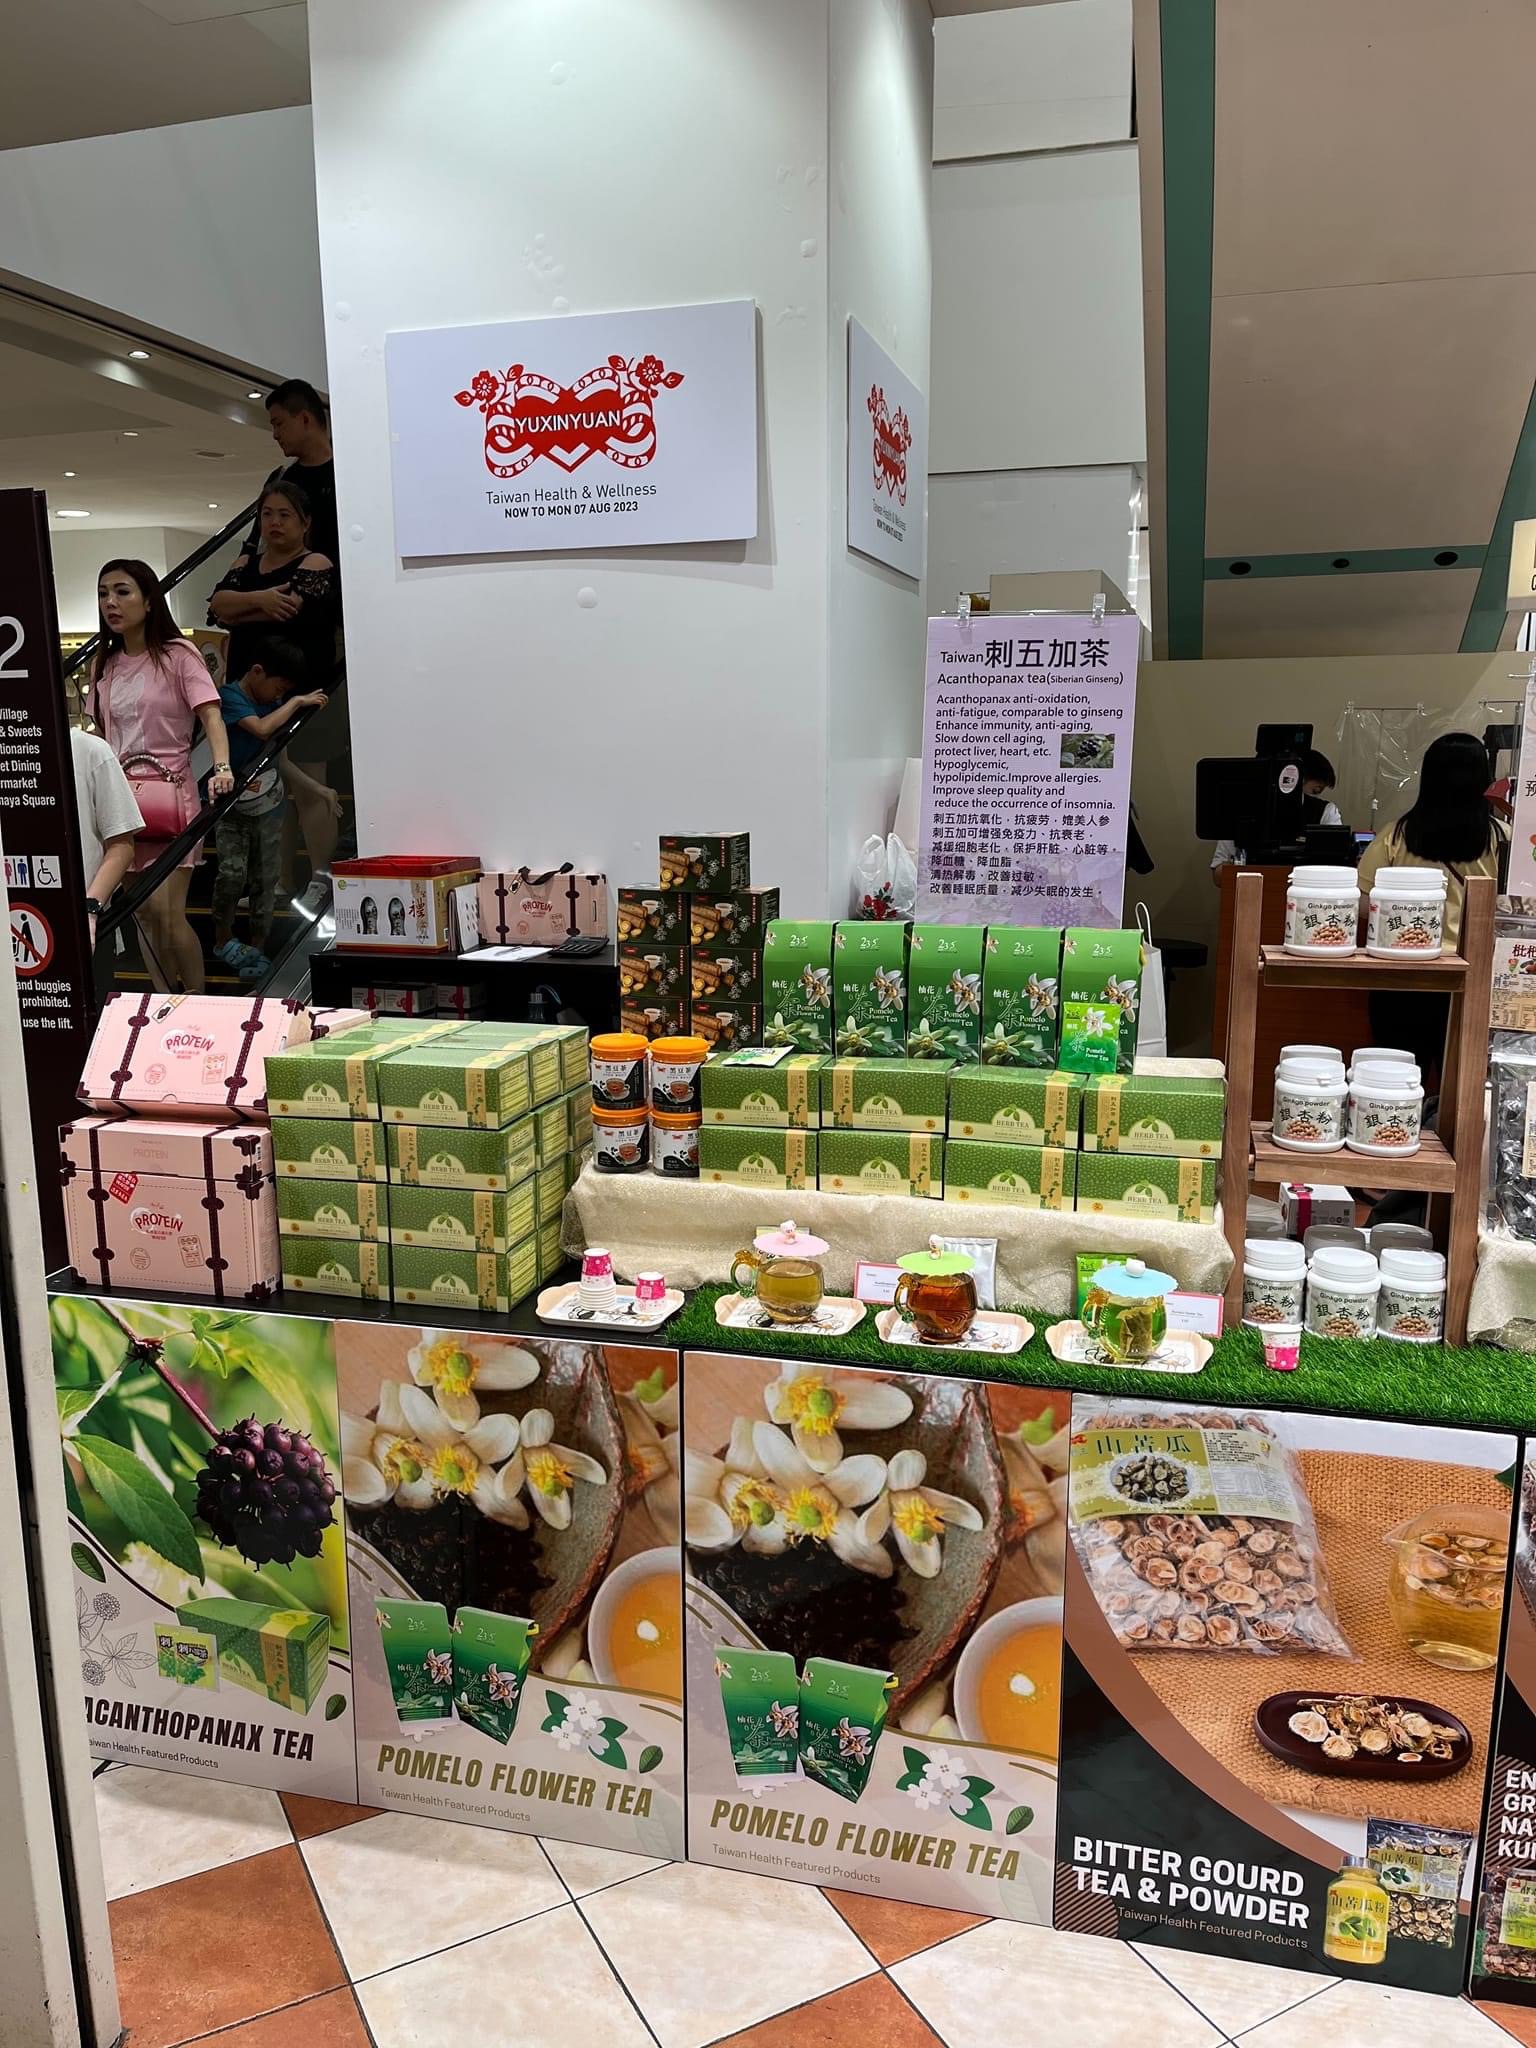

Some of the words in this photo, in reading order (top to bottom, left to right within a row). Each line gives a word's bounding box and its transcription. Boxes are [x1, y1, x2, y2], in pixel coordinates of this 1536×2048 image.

[515, 410, 621, 433] YUXINYUAN
[486, 491, 530, 504] Taiwan
[535, 487, 577, 501] Health
[582, 486, 592, 498] &
[596, 484, 657, 498] Wellness
[504, 507, 529, 518] NOW
[532, 506, 544, 517] TO
[548, 504, 571, 516] MON
[574, 504, 585, 514] 07
[589, 502, 610, 514] AUG
[614, 501, 638, 512] 2023
[941, 651, 984, 663] Taiwan
[984, 639, 1109, 668] 刺五加茶
[938, 673, 1023, 686] Acanthopanax
[1086, 672, 1124, 685] Ginseng)
[937, 694, 1010, 706] Acanthopanax
[1013, 693, 1091, 705] anti-oxidation,
[936, 707, 999, 719] anti-fatigue,
[1002, 707, 1064, 719] comparable
[1067, 709, 1077, 717] to
[1081, 708, 1123, 719] ginseng
[8, 726, 42, 737] Sweets
[936, 721, 978, 730] Enhance
[981, 721, 1032, 731] immunity,
[1035, 721, 1092, 732] anti-aging,
[935, 733, 958, 743] Slow
[962, 733, 990, 743] down
[993, 734, 1010, 743] cell
[1013, 734, 1045, 745] aging,
[935, 747, 970, 758] protect
[974, 747, 996, 757] liver,
[1000, 747, 1029, 757] heart,
[1033, 747, 1051, 756] etc.
[11, 761, 41, 773] Dining
[934, 760, 1009, 771] Hypoglycemic,
[1055, 773, 1101, 784] allergies.
[933, 786, 974, 796] Improve
[977, 786, 1004, 796] sleep
[1007, 786, 1043, 797] quality
[1045, 786, 1065, 795] and
[23, 794, 55, 808] Square
[935, 799, 970, 808] reduce
[972, 799, 988, 807] the
[991, 800, 1048, 809] occurrence
[1051, 799, 1062, 808] of
[1064, 799, 1115, 809] insomnia.
[523, 901, 552, 912] PROTEIN
[1392, 904, 1417, 912] Ginkgo
[1304, 913, 1356, 930] 銀杏粉
[1387, 915, 1440, 932] 銀杏粉
[16, 979, 33, 990] and
[35, 979, 71, 993] buggies
[22, 996, 71, 1008] prohibited.
[23, 1018, 39, 1028] use
[41, 1017, 56, 1029] the
[58, 1017, 73, 1029] lift.
[166, 1034, 215, 1051] PROTEIN
[1369, 1102, 1393, 1111] Ginkgo
[1280, 1108, 1332, 1125] 銀杏粉
[1364, 1113, 1418, 1128] 銀杏粉
[135, 1213, 183, 1232] PROTEIN
[1242, 1290, 1295, 1309] 銀杏粉
[1320, 1292, 1343, 1302] Ginkgo
[1390, 1291, 1414, 1302] Ginkgo
[1316, 1303, 1371, 1321] 銀杏粉
[1385, 1302, 1441, 1320] 銀杏粉
[271, 1727, 314, 1762] TEA
[89, 1738, 112, 1750] aiwan
[112, 1740, 140, 1755] Health
[140, 1746, 179, 1762] Featured
[180, 1752, 218, 1768] Products
[377, 1744, 483, 1788] POMELO
[490, 1763, 597, 1808] FLOWER
[605, 1782, 653, 1818] TEA
[380, 1786, 411, 1802] Taiwan
[413, 1791, 444, 1807] Health
[444, 1798, 486, 1814] Featured
[487, 1804, 531, 1823] Products
[1501, 1815, 1536, 1837] NA
[710, 1799, 828, 1847] POMELO
[836, 1822, 957, 1870] FLOWER
[968, 1843, 1020, 1881] TEA
[711, 1843, 747, 1860] Taiwan
[749, 1849, 782, 1866] Health
[784, 1856, 831, 1874] Featured
[833, 1865, 881, 1884] Products
[1074, 1835, 1182, 1878] BITTER
[1189, 1855, 1304, 1897] GOURD
[1071, 1865, 1130, 1900] TEA
[1137, 1877, 1161, 1905] &
[1169, 1881, 1310, 1929] POWDER
[1117, 1906, 1157, 1923] Taiwan
[1159, 1913, 1197, 1930] Health
[1199, 1920, 1252, 1939] Featured
[1254, 1930, 1308, 1949] Products
